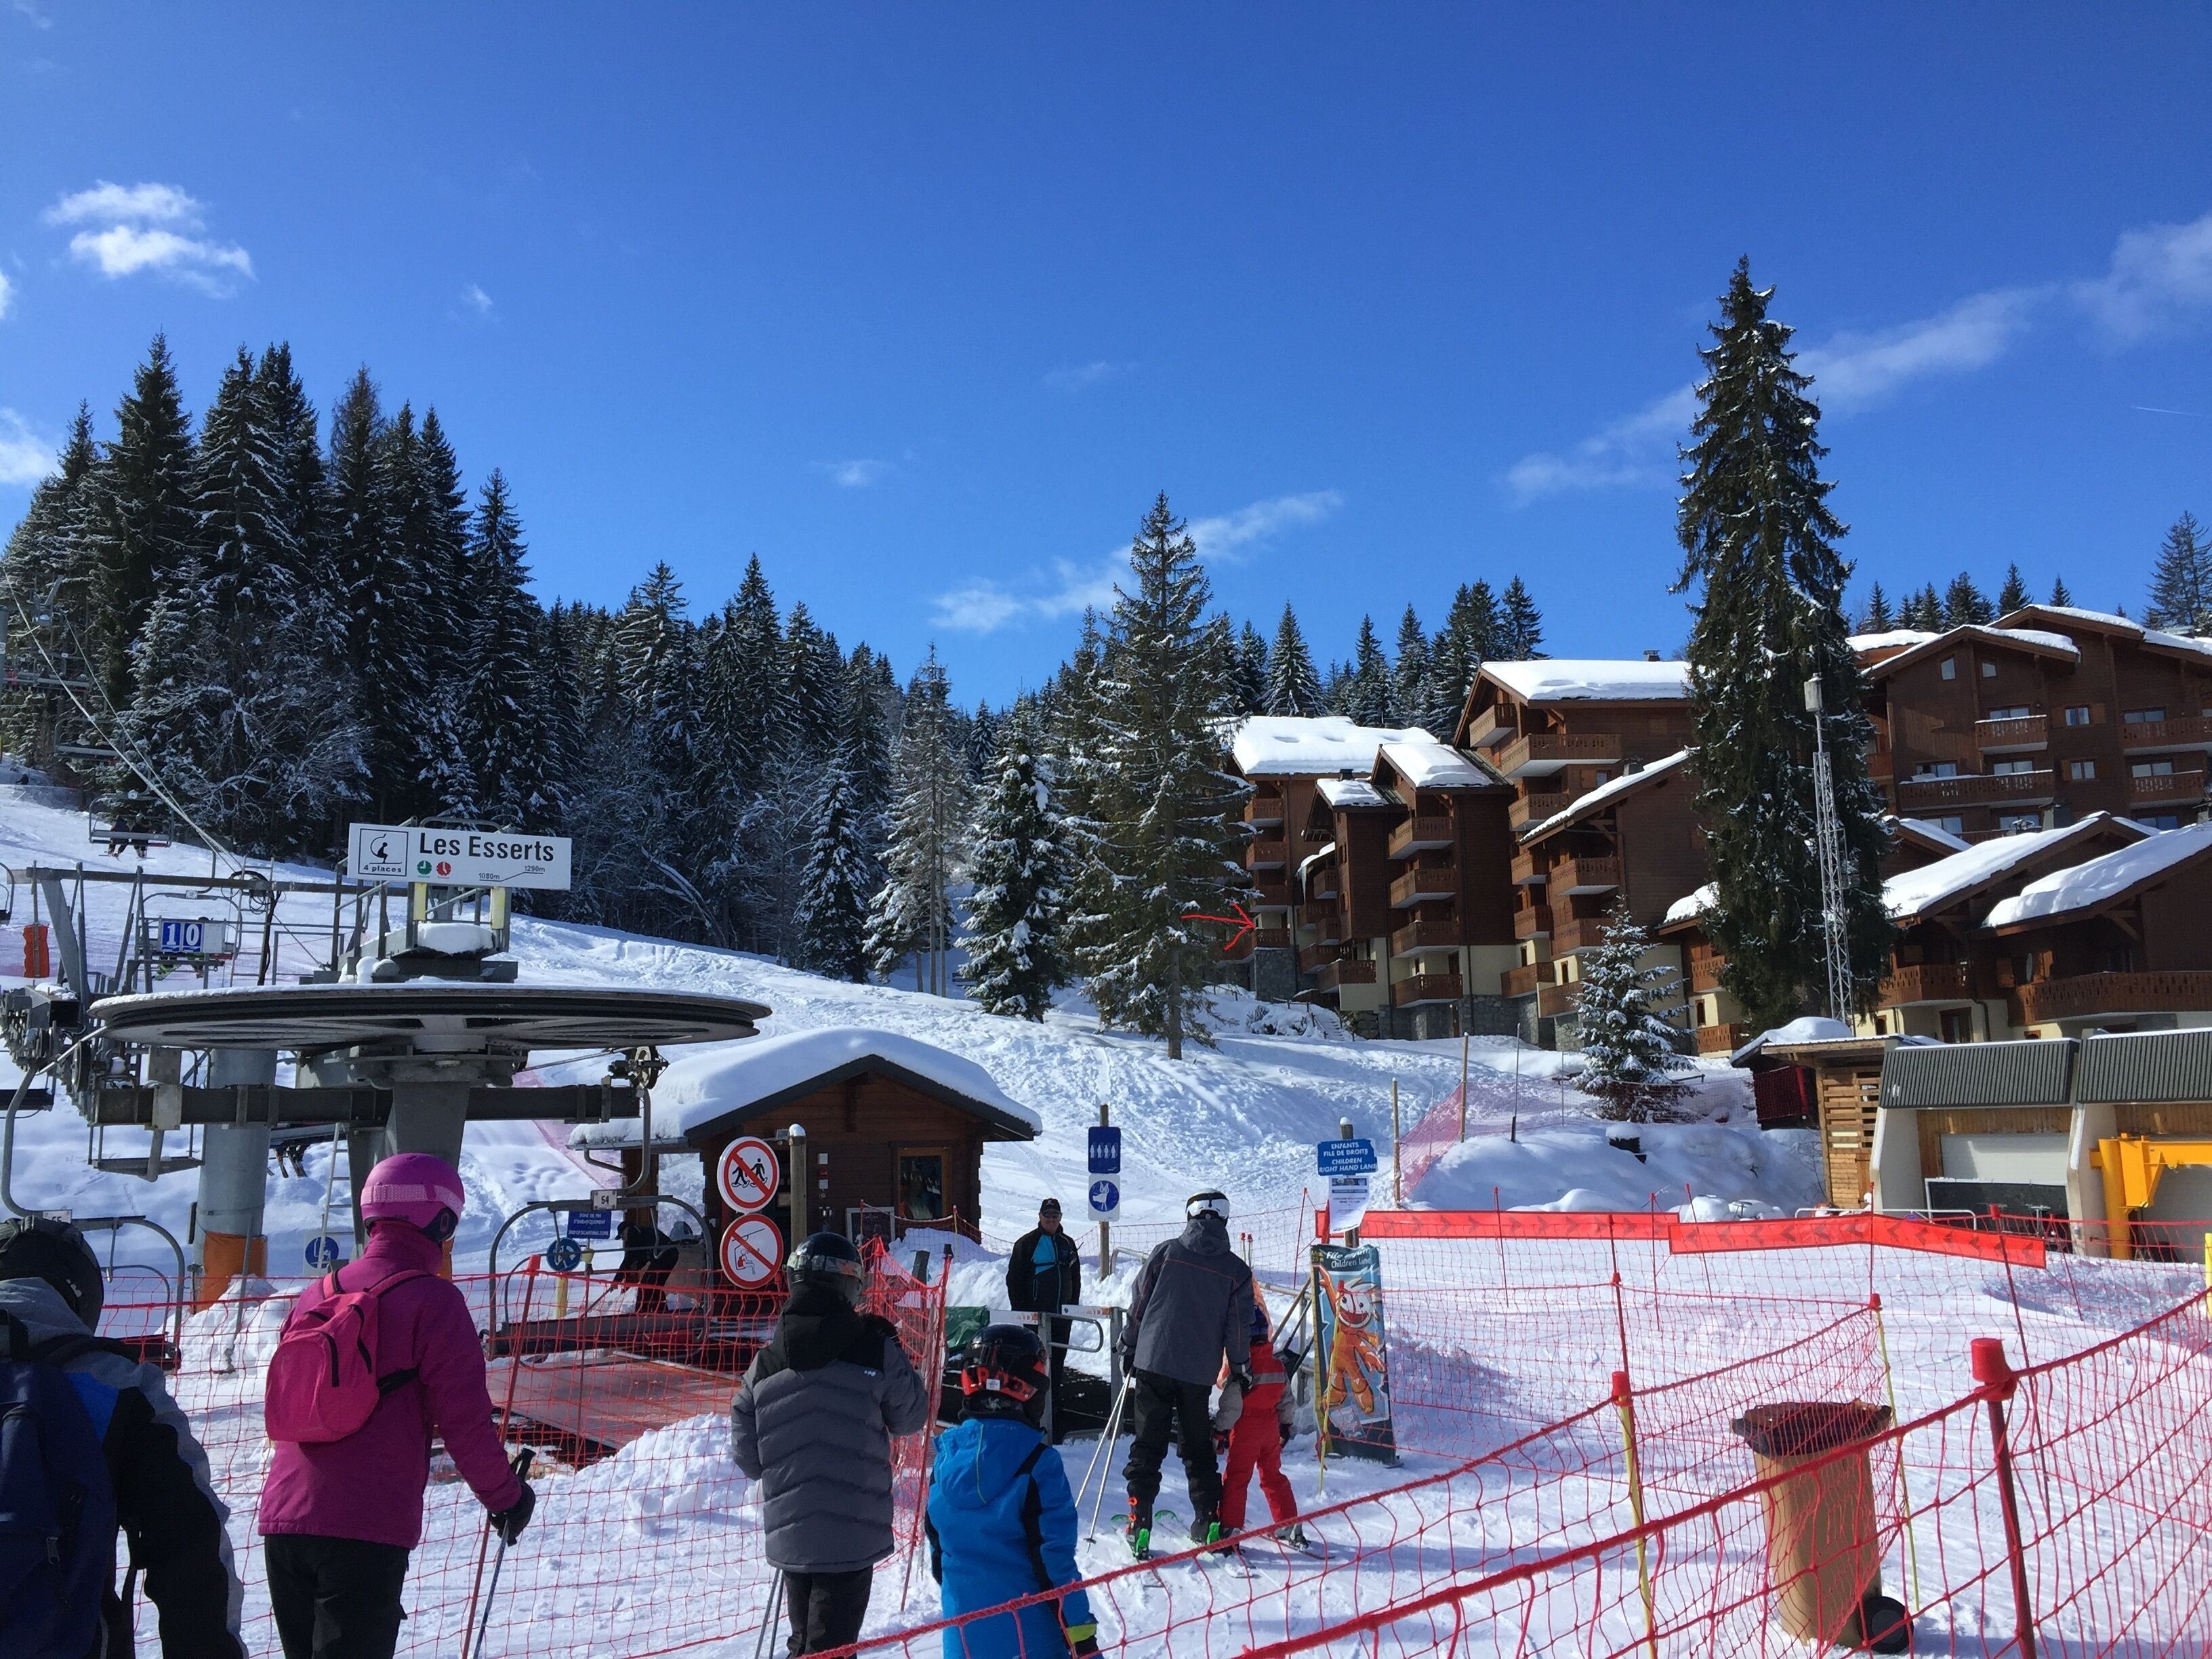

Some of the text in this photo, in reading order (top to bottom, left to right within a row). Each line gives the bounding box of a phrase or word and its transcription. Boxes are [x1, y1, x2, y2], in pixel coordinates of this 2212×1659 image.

[419, 832, 554, 862] Les Esserts
[166, 924, 199, 946] 10
[1332, 1157, 1363, 1166] CHILDREN
[601, 1195, 609, 1204] 54
[1331, 1259, 1357, 1269] Children
